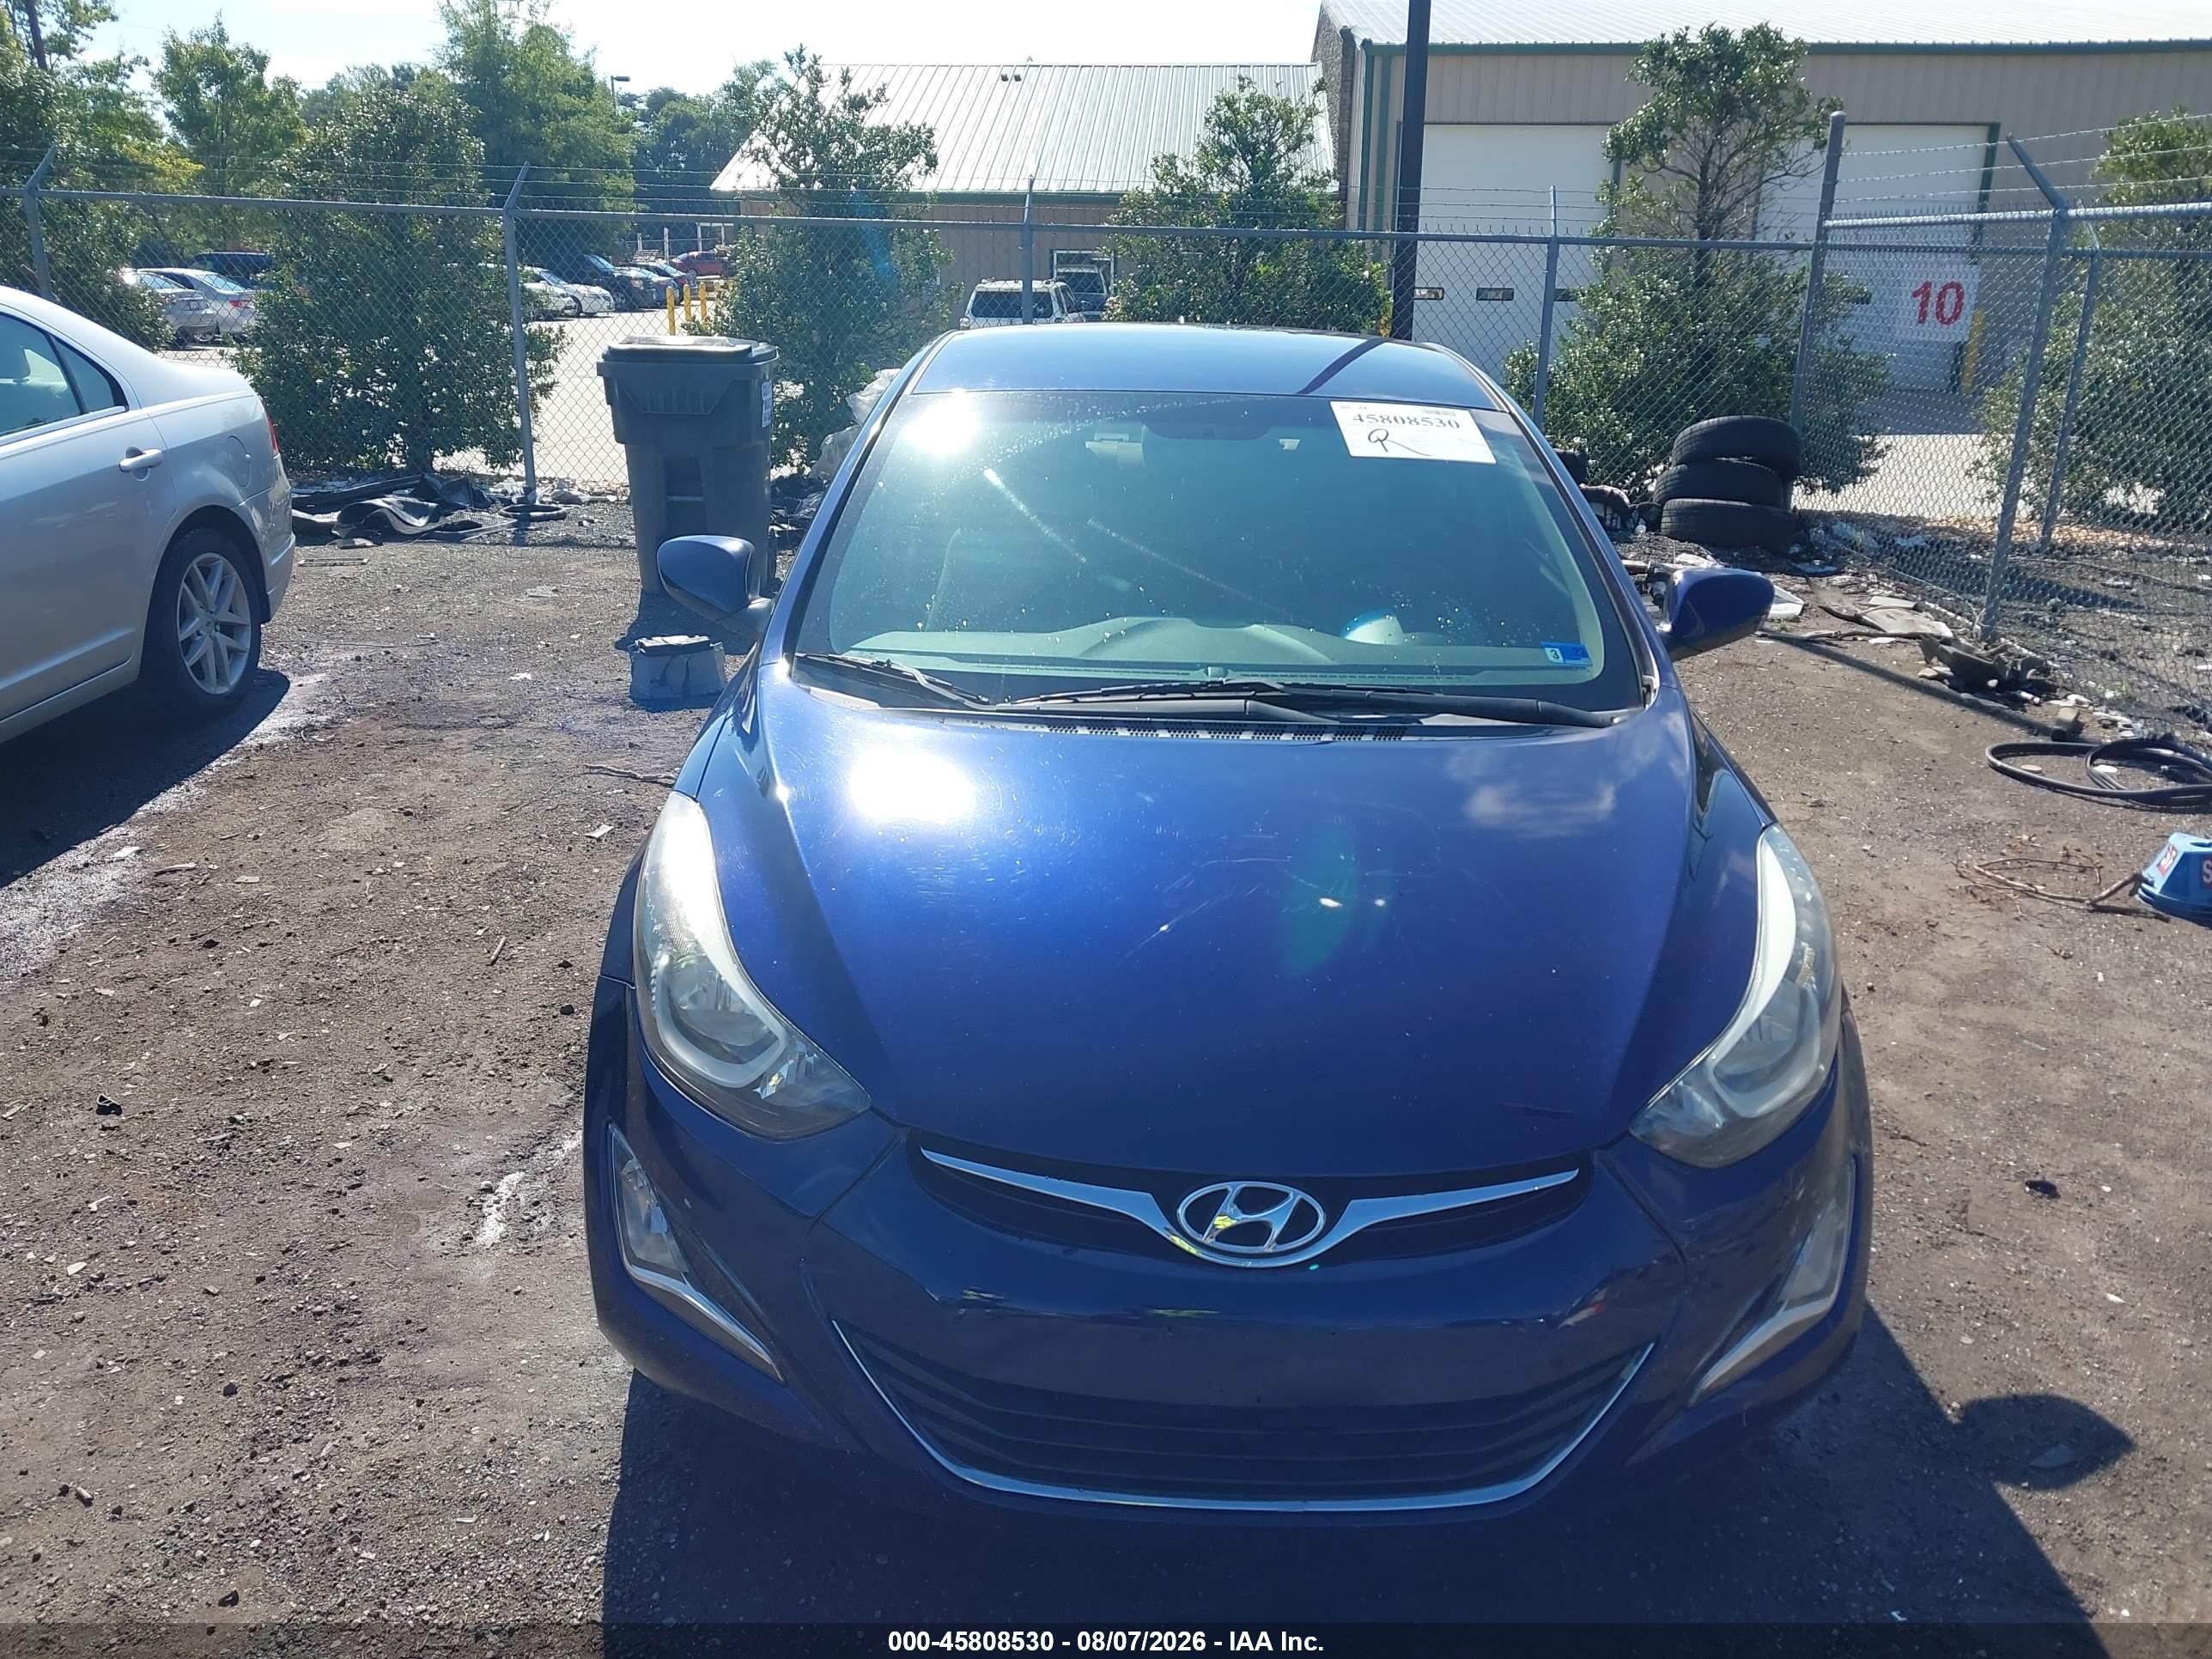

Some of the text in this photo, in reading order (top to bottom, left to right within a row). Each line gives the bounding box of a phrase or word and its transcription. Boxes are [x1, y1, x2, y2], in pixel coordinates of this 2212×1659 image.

[1911, 280, 1966, 326] 10
[1352, 412, 1461, 429] 45808530
[1549, 648, 1560, 659] 3
